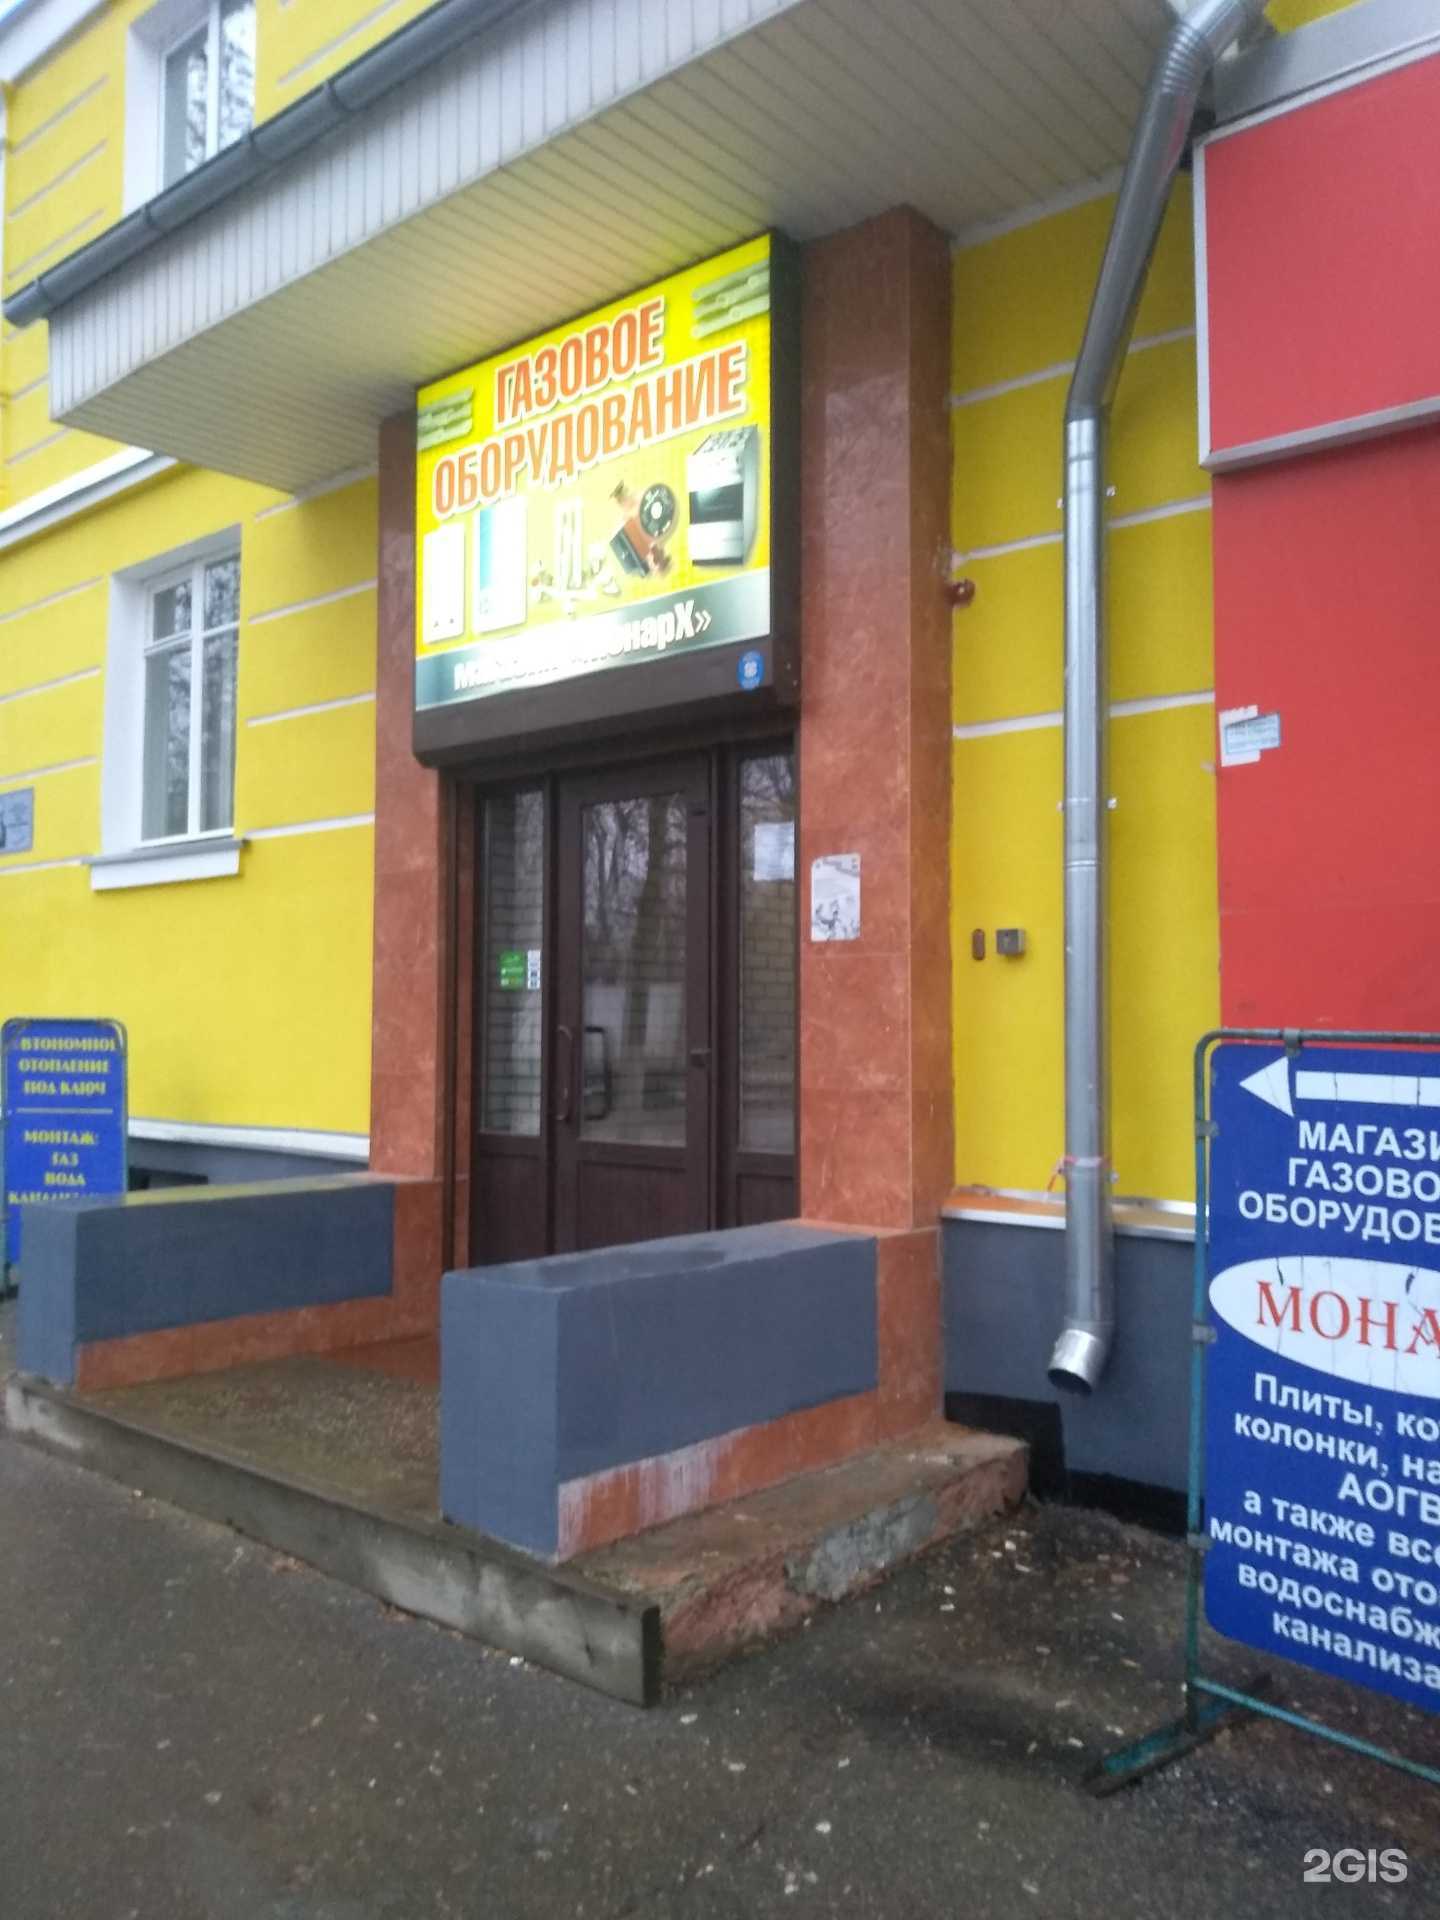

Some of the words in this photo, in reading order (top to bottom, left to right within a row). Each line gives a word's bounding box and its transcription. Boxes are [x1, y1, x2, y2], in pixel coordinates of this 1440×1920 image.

[496, 298, 664, 425] ГАЗОВОЕ
[434, 345, 747, 516] ОБОРУДОВАНИЕ
[1254, 1372, 1384, 1435] Плиты,
[1397, 1411, 1440, 1442] ко
[1234, 1412, 1389, 1478] колонки,
[1243, 1489, 1262, 1516] а
[1271, 1497, 1375, 1548] также
[1338, 1472, 1440, 1526] АОГВ
[1210, 1516, 1359, 1584] монтажа
[1371, 1567, 1440, 1608] ото
